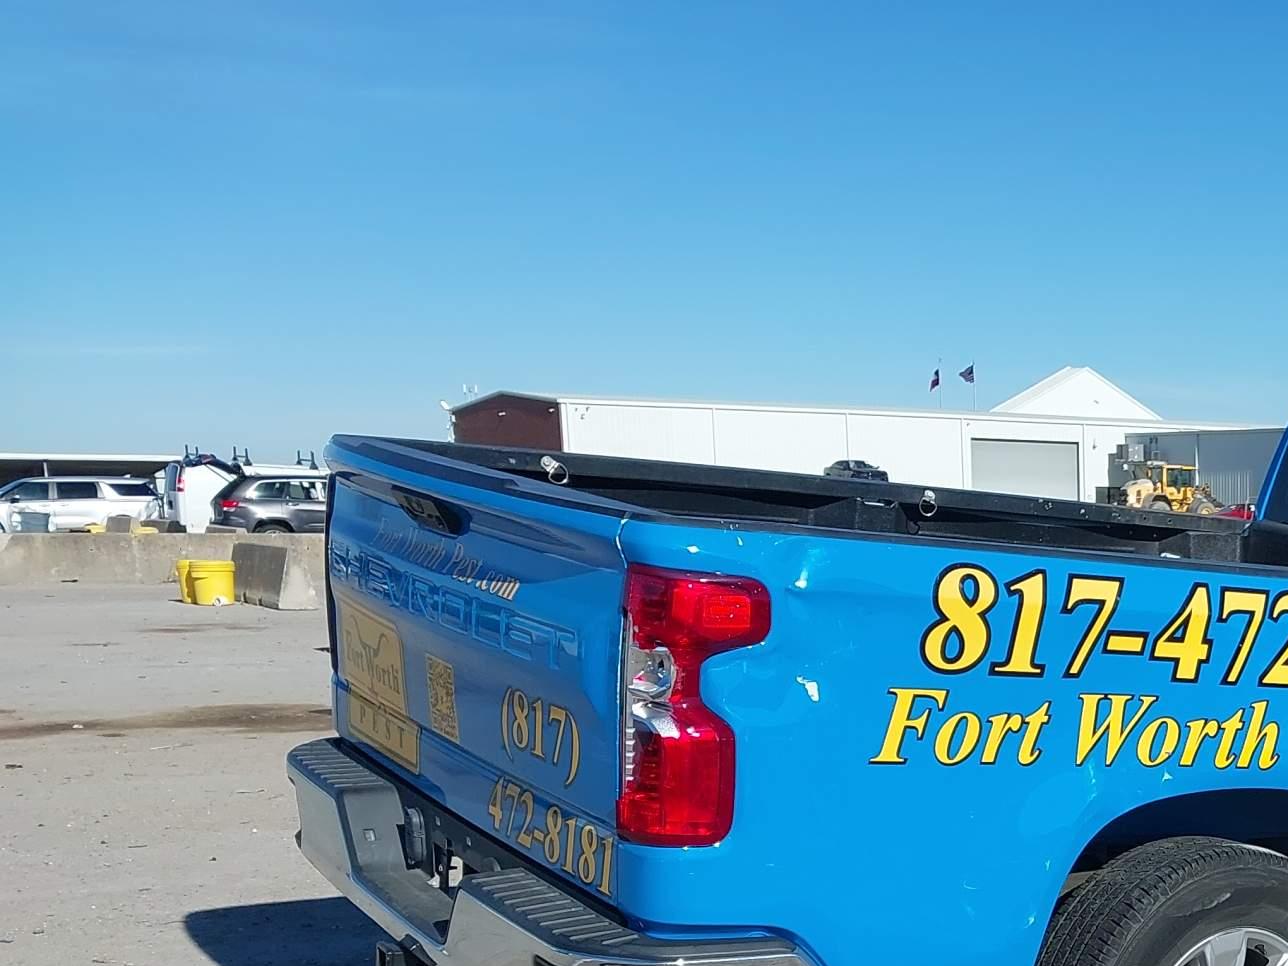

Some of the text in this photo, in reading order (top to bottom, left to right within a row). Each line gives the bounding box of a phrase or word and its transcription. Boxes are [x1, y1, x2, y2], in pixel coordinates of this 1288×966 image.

[330, 541, 580, 670] CHEVROLET
[501, 687, 580, 789] (817)
[869, 686, 1051, 767] Fort
[1074, 692, 1282, 771] Worth
[488, 775, 614, 898] 472-8181
